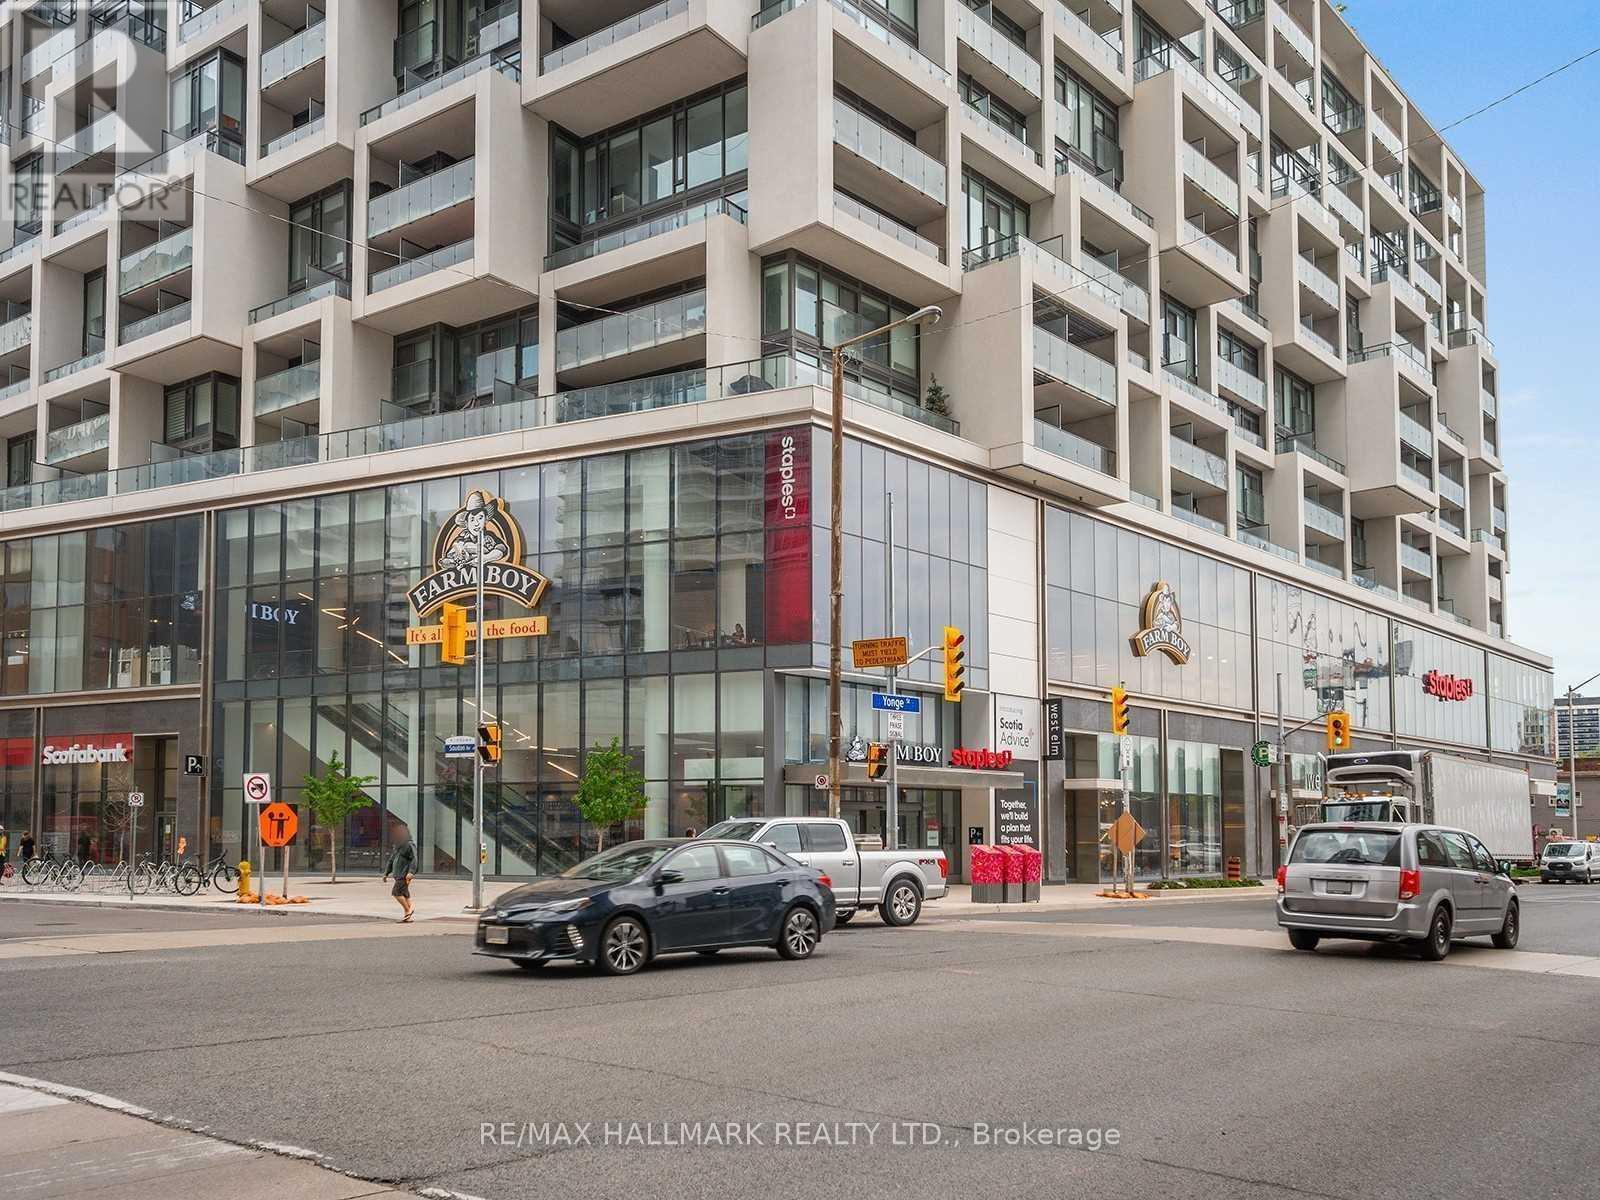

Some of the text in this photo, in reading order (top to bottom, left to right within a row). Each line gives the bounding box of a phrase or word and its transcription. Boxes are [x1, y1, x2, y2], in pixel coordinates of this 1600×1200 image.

[780, 436, 795, 507] staples
[413, 565, 537, 608] FARM BOY
[411, 629, 426, 642] It's
[487, 623, 505, 637] the
[510, 621, 540, 635] food.
[1143, 630, 1190, 655] FARM BOY
[882, 695, 905, 711] Yonge
[1000, 717, 1023, 731] Scotia
[1050, 704, 1061, 756] west elm
[1000, 732, 1029, 747] Advice
[43, 743, 128, 765] Scotiabank
[914, 745, 942, 763] BOY
[1000, 800, 1027, 810] Together,
[1014, 811, 1029, 820] build
[1006, 824, 1019, 833] plan
[1020, 824, 1031, 832] that
[1010, 836, 1023, 845] your
